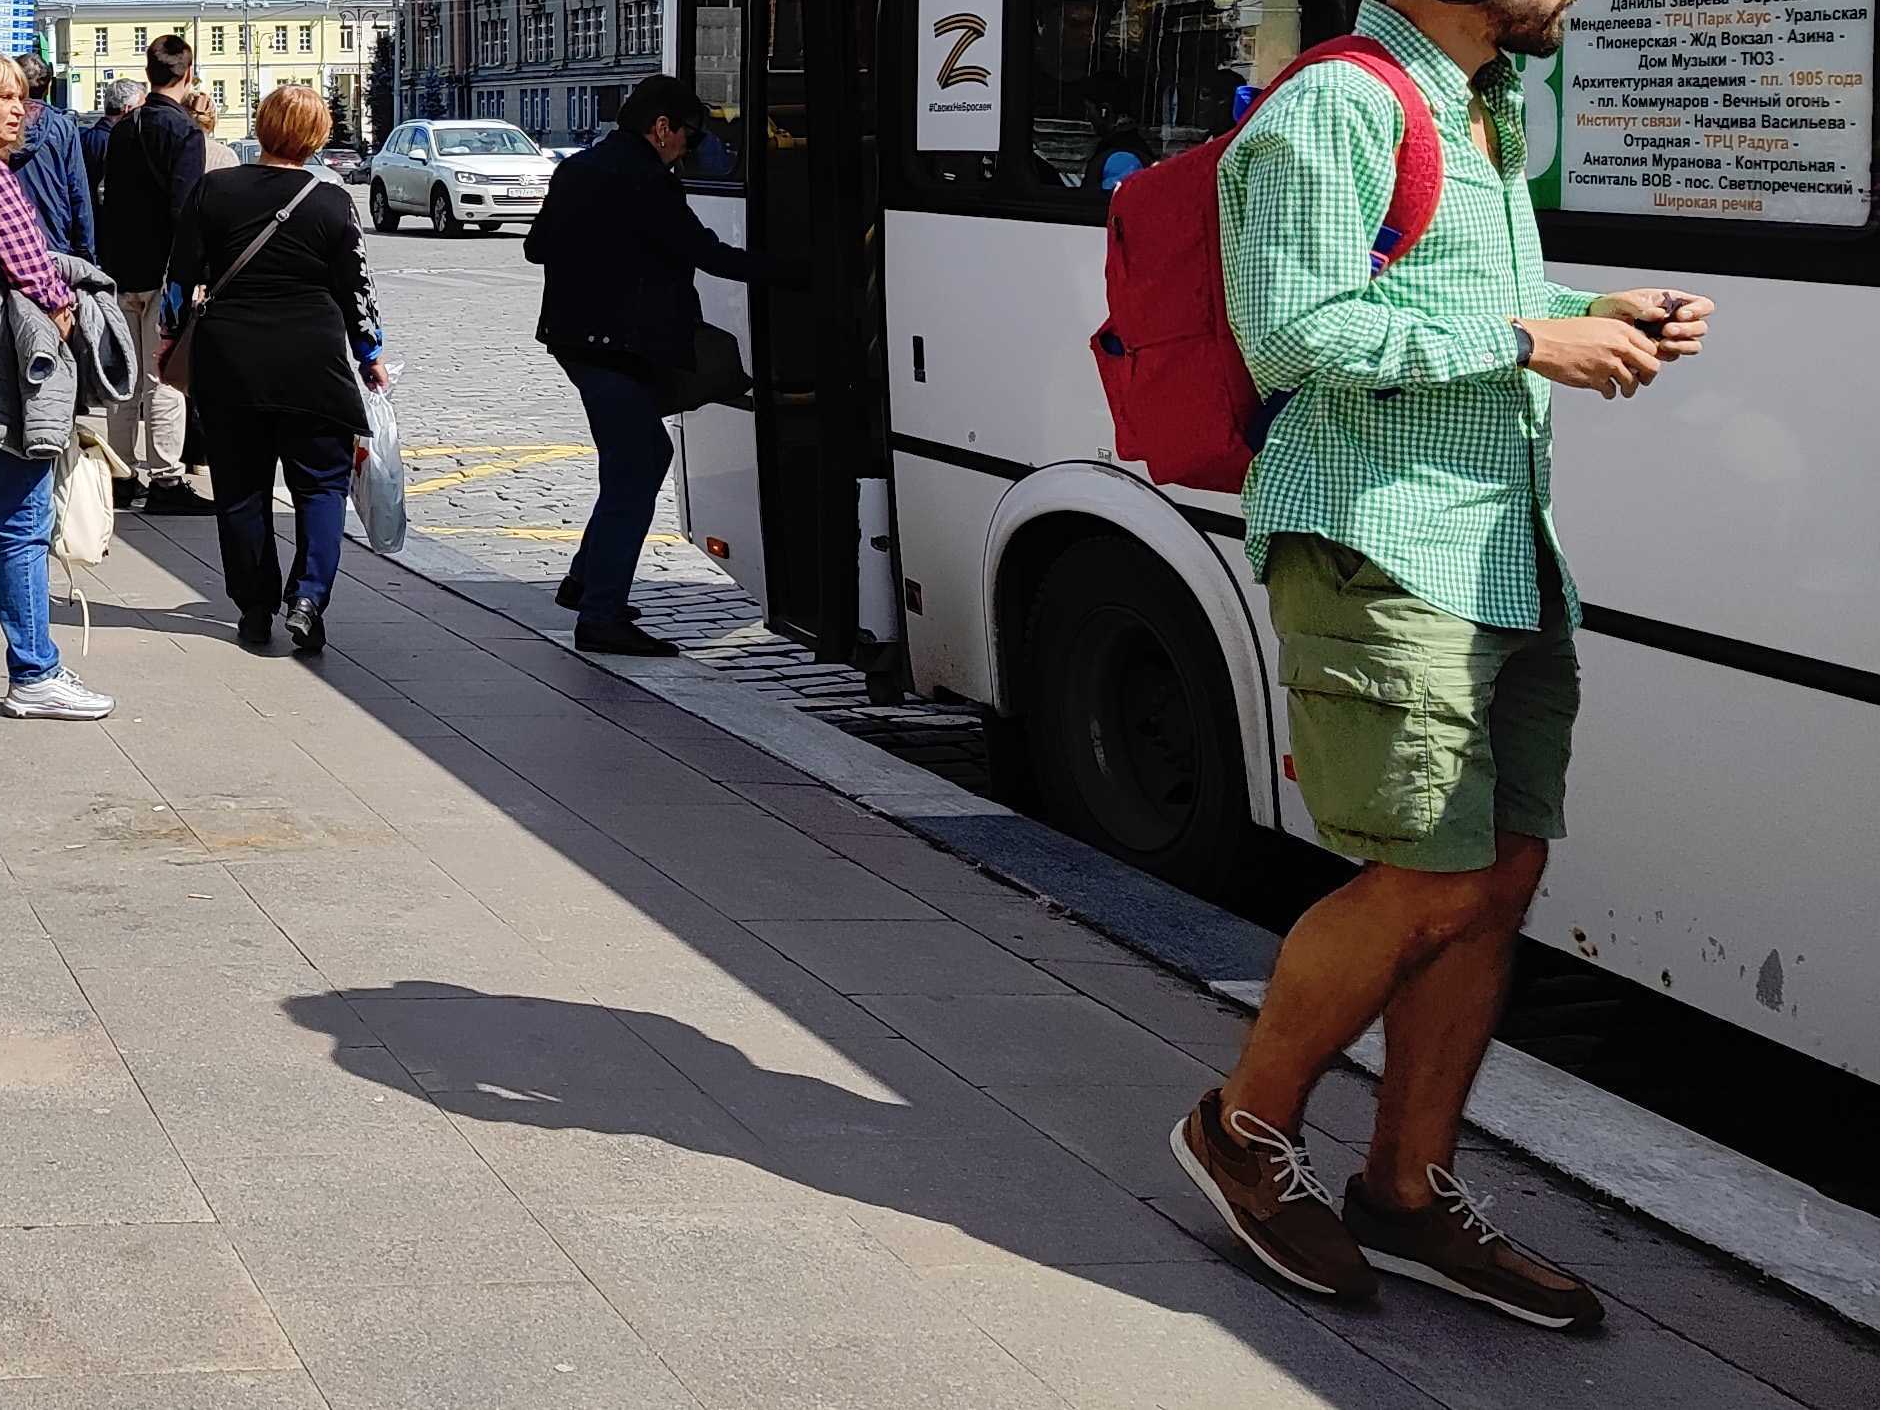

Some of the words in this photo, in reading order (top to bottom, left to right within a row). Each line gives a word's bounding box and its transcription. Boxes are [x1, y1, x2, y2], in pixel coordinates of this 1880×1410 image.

[1571, 18, 1651, 32] Менделеева
[1664, 12, 1693, 28] ТРЦ
[1698, 12, 1732, 28] Парк
[1736, 11, 1771, 27] Хаус
[1785, 8, 1867, 23] Уральская
[1597, 36, 1677, 51] Пионерская
[1690, 32, 1717, 48] Ж/д
[1721, 32, 1773, 45] Вокзал
[1787, 30, 1834, 43] Азина
[933, 12, 992, 90] Z
[1638, 55, 1667, 70] Дом
[1672, 54, 1726, 70] Музыки
[1740, 52, 1774, 65] ТЮЗ
[1572, 75, 1673, 91] Архитектурная
[1678, 76, 1745, 89] академия
[1761, 76, 1783, 86] пл.
[1789, 71, 1824, 86] 1905
[1828, 74, 1862, 87] года
[1598, 98, 1617, 107] пл.
[1622, 94, 1708, 111] Коммунаров
[1723, 93, 1780, 107] Вечный
[1786, 97, 1830, 107] огонь
[1577, 114, 1638, 130] Институт
[1642, 117, 1681, 127] связи
[1695, 115, 1756, 130] Начдива
[1761, 114, 1845, 129] Васильева
[1624, 134, 1690, 150] Отрадная
[1704, 134, 1733, 150] ТРЦ
[1738, 135, 1788, 152] Радуга
[1583, 152, 1647, 166] Анатолия
[1652, 154, 1721, 171] Муранова
[1736, 155, 1835, 174] Контрольная
[1569, 171, 1637, 186] Госпиталь
[1642, 173, 1672, 187] ВОВ
[1685, 178, 1713, 189] пос.
[1719, 176, 1852, 194] Светлореченский
[1654, 193, 1717, 211] Широкая
[1722, 200, 1762, 213] речка
